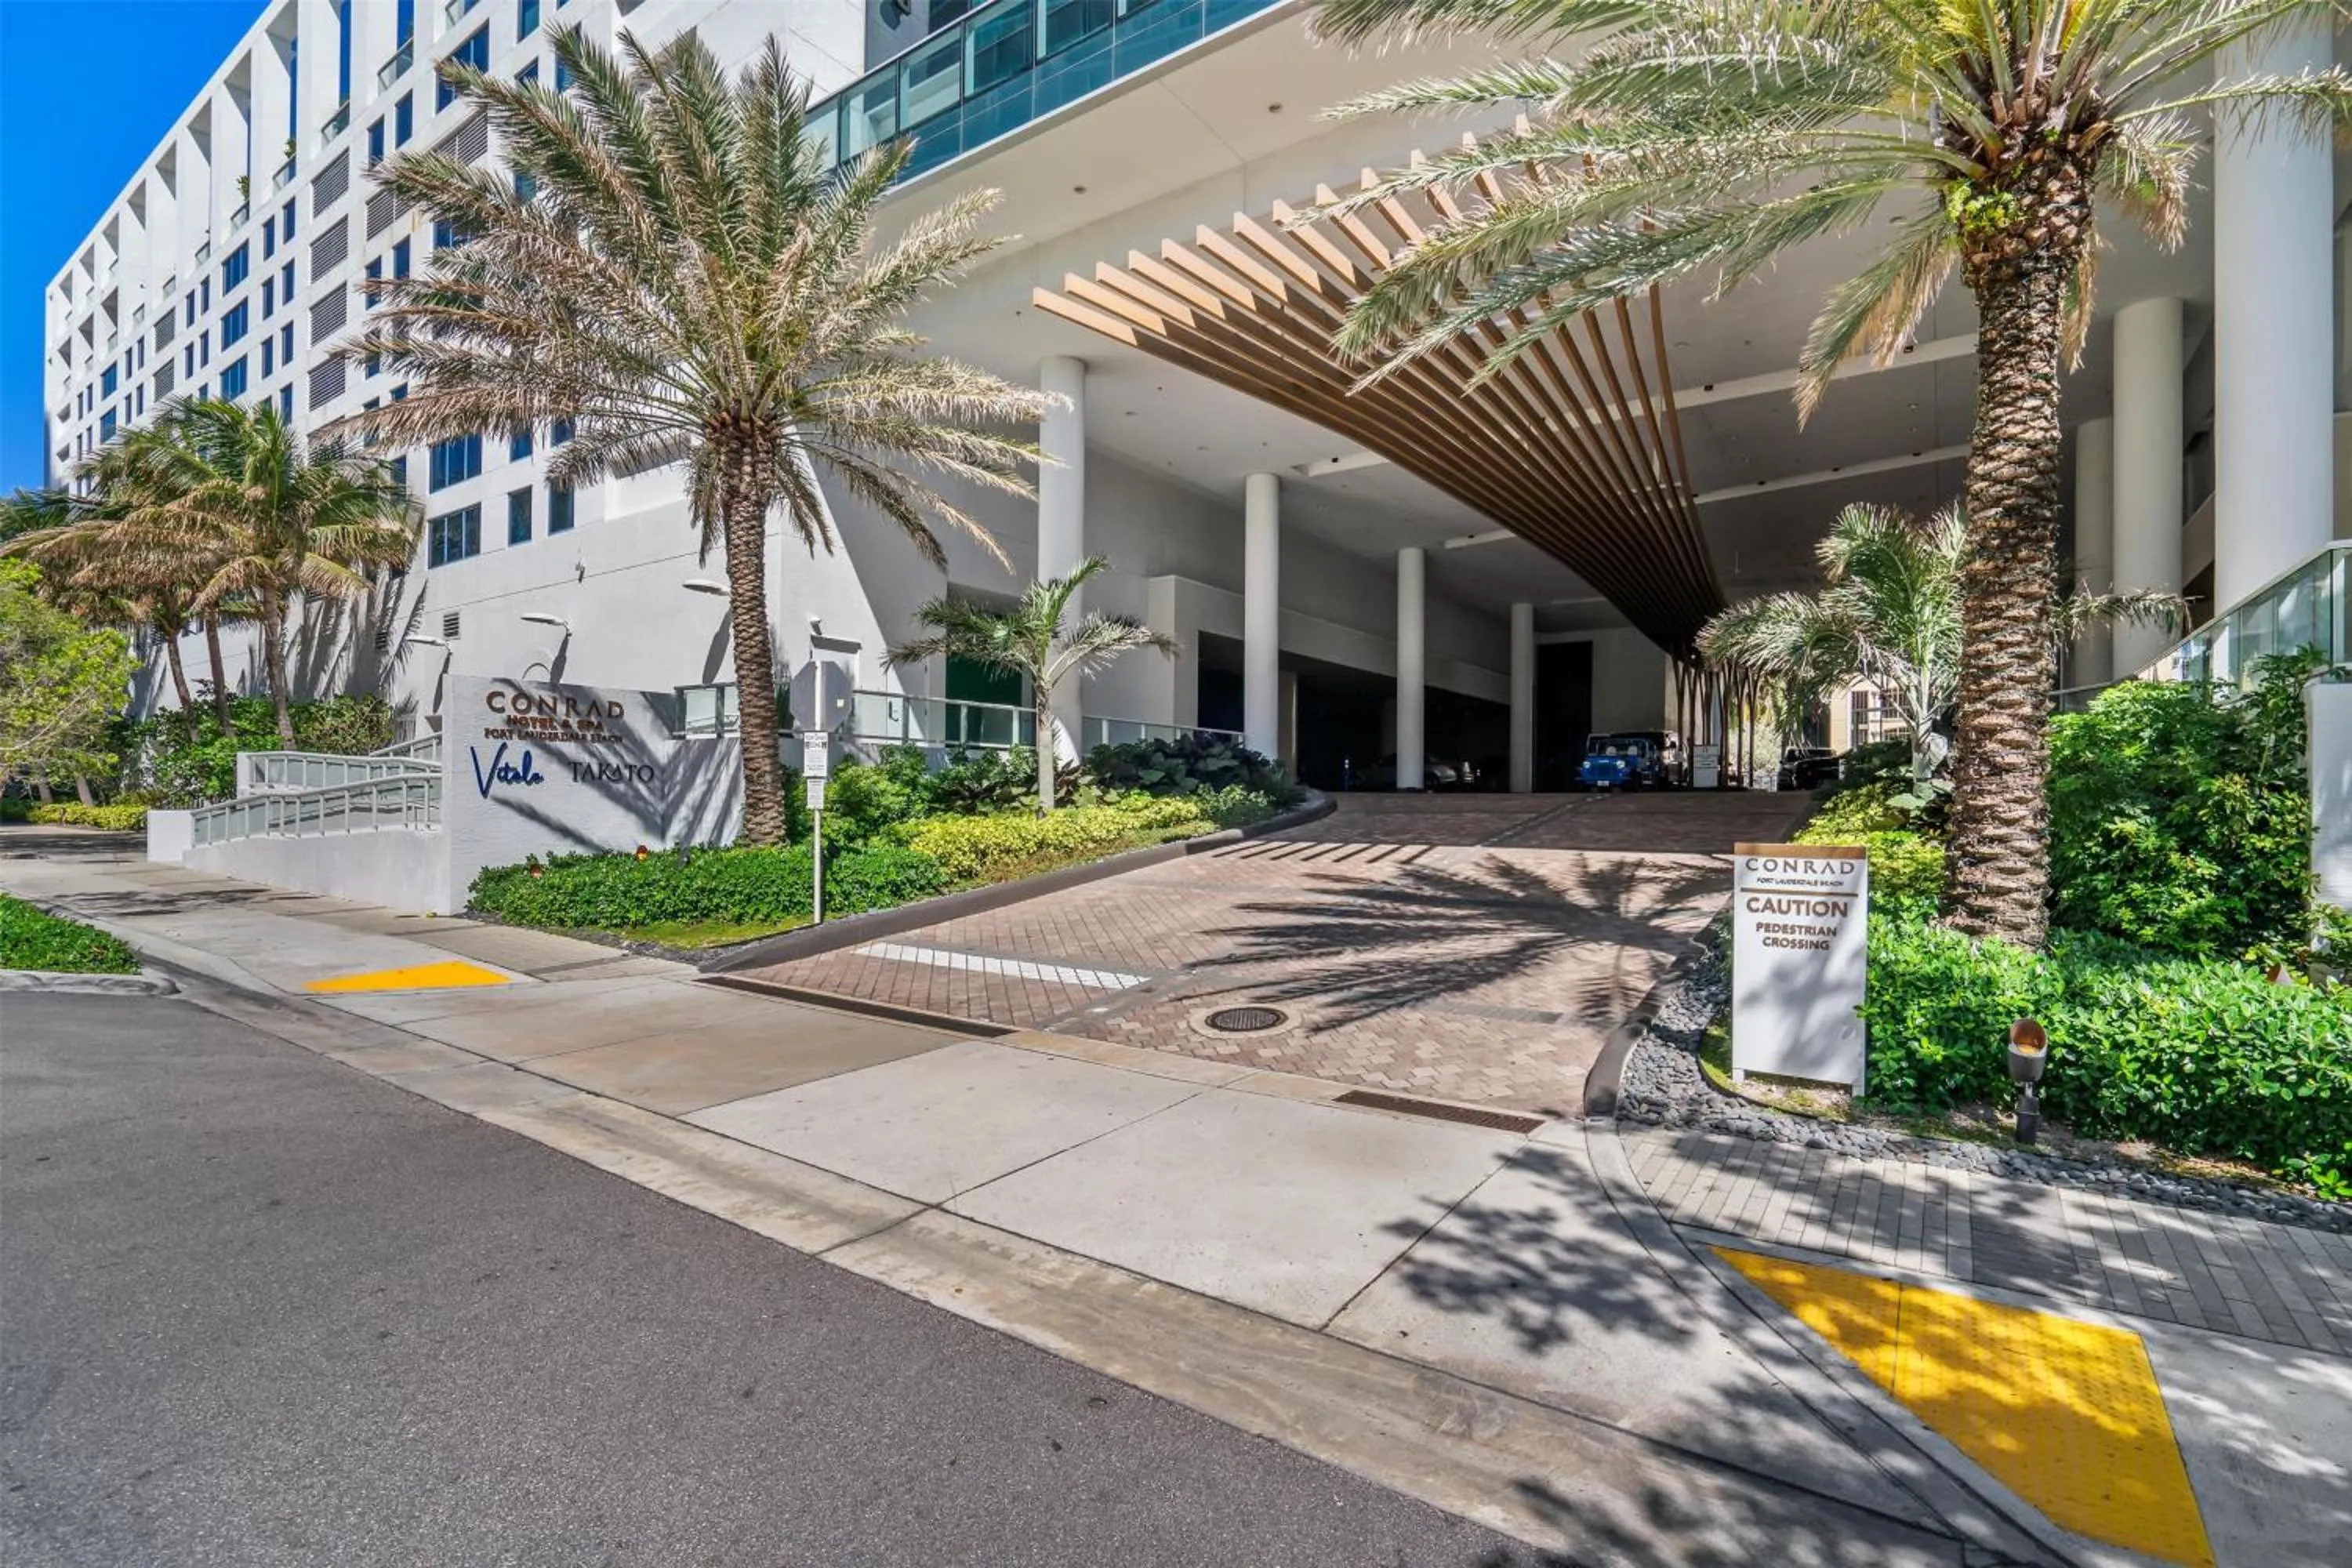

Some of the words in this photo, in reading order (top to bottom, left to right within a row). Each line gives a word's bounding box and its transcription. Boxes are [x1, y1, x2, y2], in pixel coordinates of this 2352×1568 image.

[486, 691, 625, 720] CONRAD
[506, 715, 557, 730] HOTEL
[577, 718, 603, 731] SPA
[484, 728, 514, 740] FORT
[517, 729, 587, 742] LAUDERDALE
[590, 733, 623, 743] BEACH
[568, 761, 655, 783] TAKATO
[1745, 857, 1855, 875] CONRAD
[1775, 878, 1818, 887] LAUDERDALE
[1746, 896, 1849, 918] CAUTION
[1755, 922, 1838, 937] PEDESTRIAN
[1762, 937, 1831, 951] CROSSING
